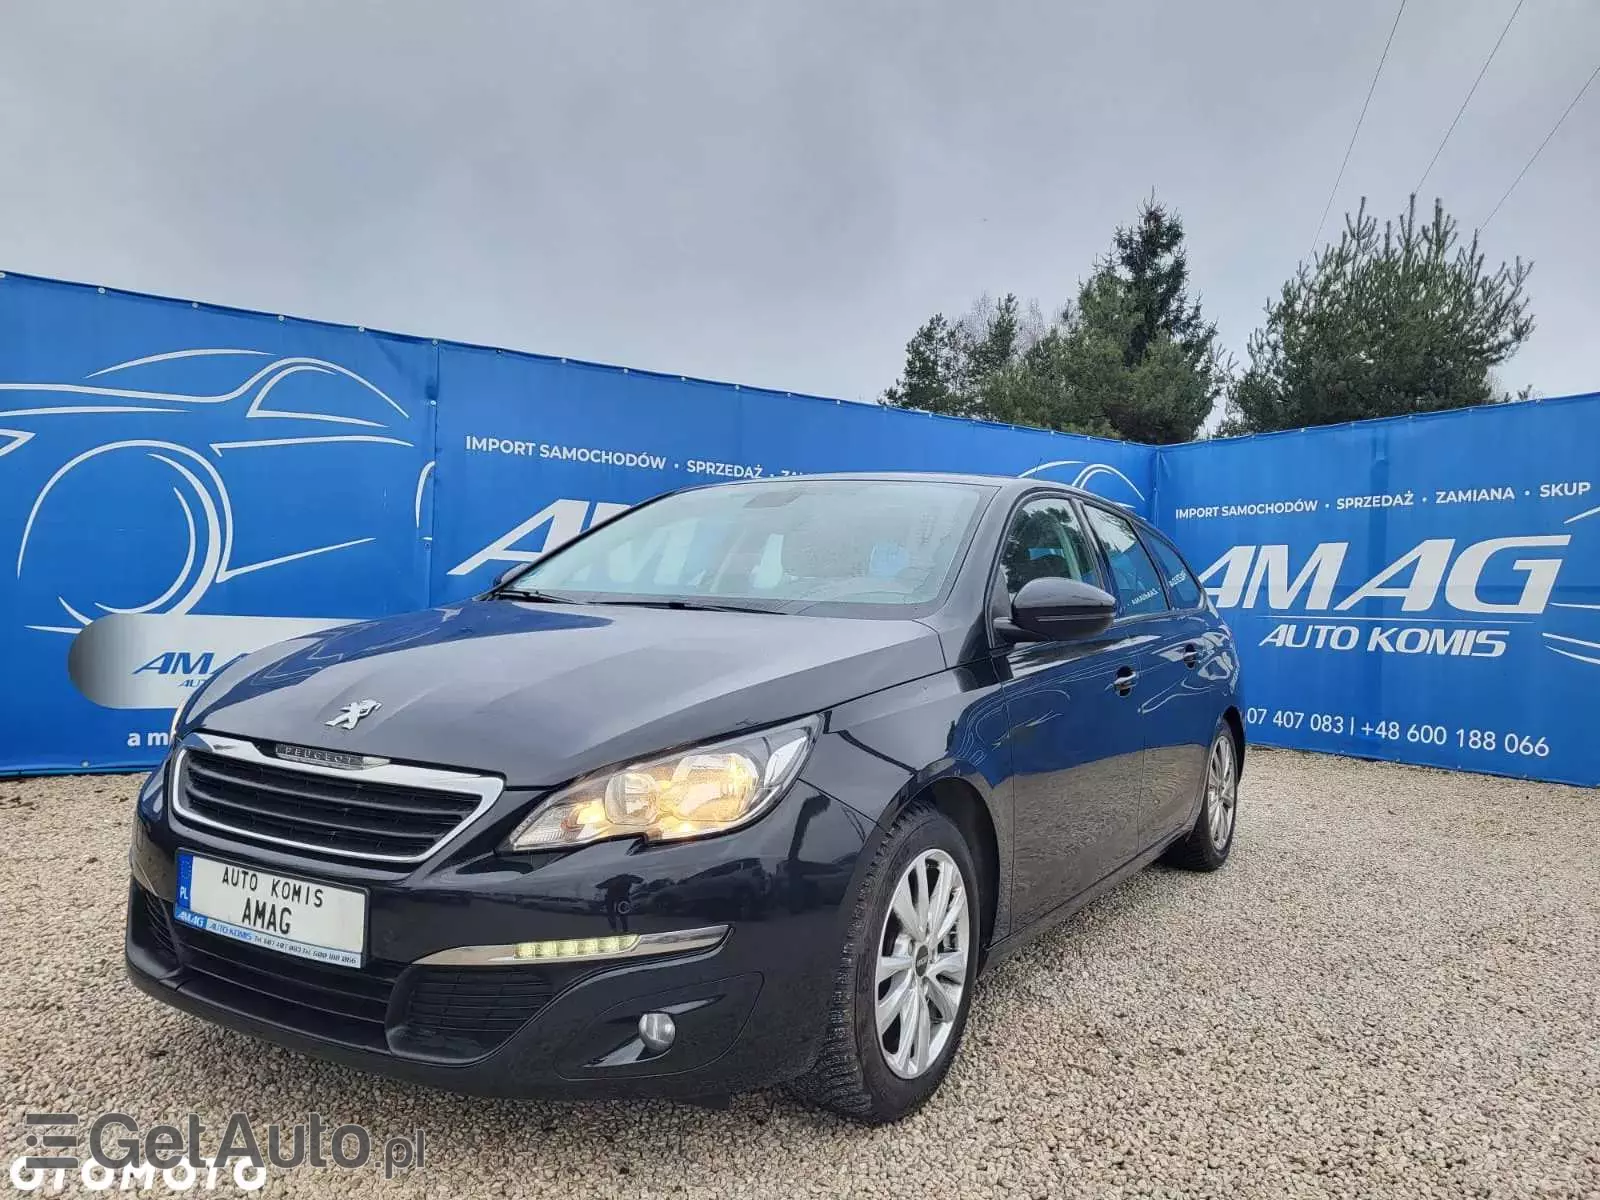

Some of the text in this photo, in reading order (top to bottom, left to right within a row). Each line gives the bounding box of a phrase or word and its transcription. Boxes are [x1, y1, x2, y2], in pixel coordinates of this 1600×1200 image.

[466, 435, 763, 479] IMPORT SAMOCHODÓW SPRZEDAŻ
[1175, 481, 1592, 520] IMPORT SAMOCHODÓW SPRZEDAŻ ZAMIANA SKUP
[1258, 624, 1511, 658] AUTO KOMIS
[131, 651, 246, 675] AM
[1246, 707, 1550, 757] 07 407 083 +48 600 188 066
[285, 746, 352, 764] PEUGEOT
[179, 886, 189, 900] PL
[222, 866, 324, 908] AUTO KOMIS
[241, 897, 292, 935] AMAG
